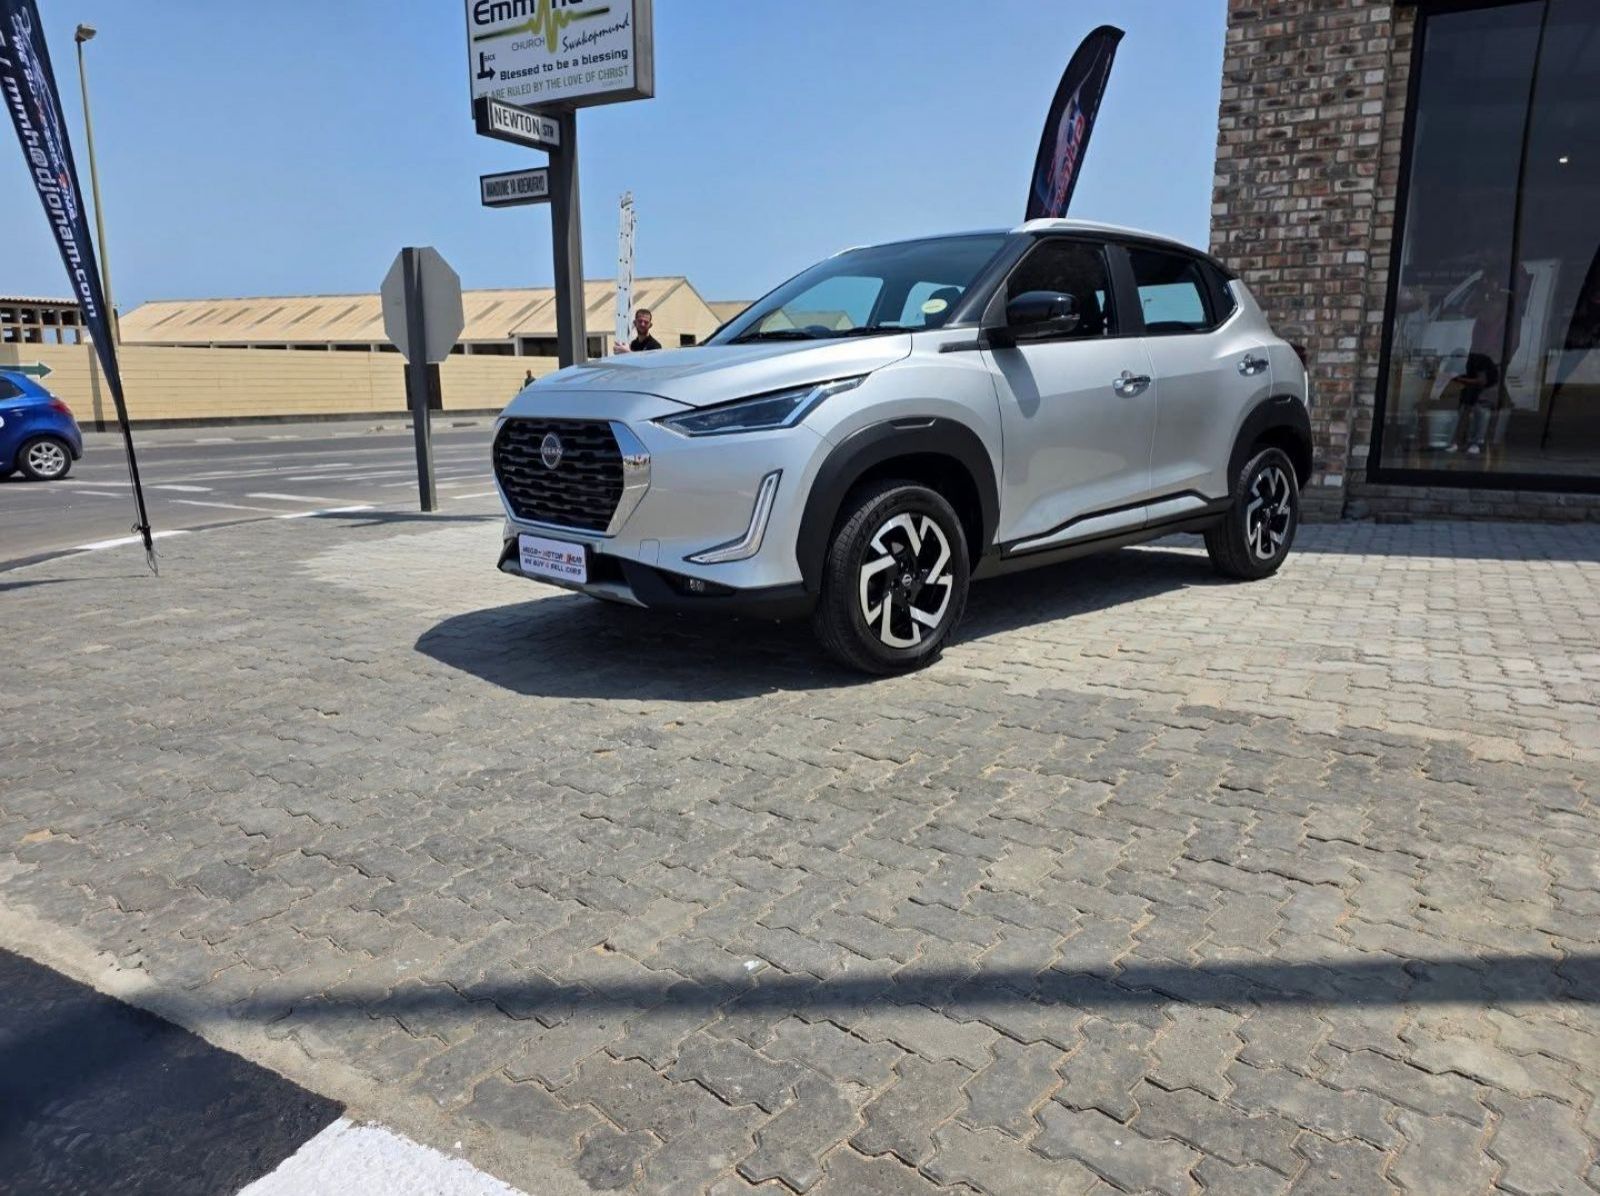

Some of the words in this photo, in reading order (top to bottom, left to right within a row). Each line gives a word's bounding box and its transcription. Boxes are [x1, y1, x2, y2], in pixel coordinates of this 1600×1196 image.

[511, 37, 546, 51] CHURCH
[561, 12, 630, 53] Swakopmund
[500, 64, 540, 81] Blessed
[542, 62, 554, 73] to
[556, 58, 570, 71] be
[572, 57, 580, 67] a
[581, 49, 629, 66] blessing
[490, 89, 505, 101] ARE
[506, 83, 532, 98] RULED
[533, 81, 544, 93] BY
[545, 77, 563, 91] THE
[563, 73, 583, 87] LOVE
[585, 71, 596, 82] OF
[597, 65, 629, 81] CHRIST
[494, 105, 541, 136] NEWTON
[542, 124, 554, 138] STR
